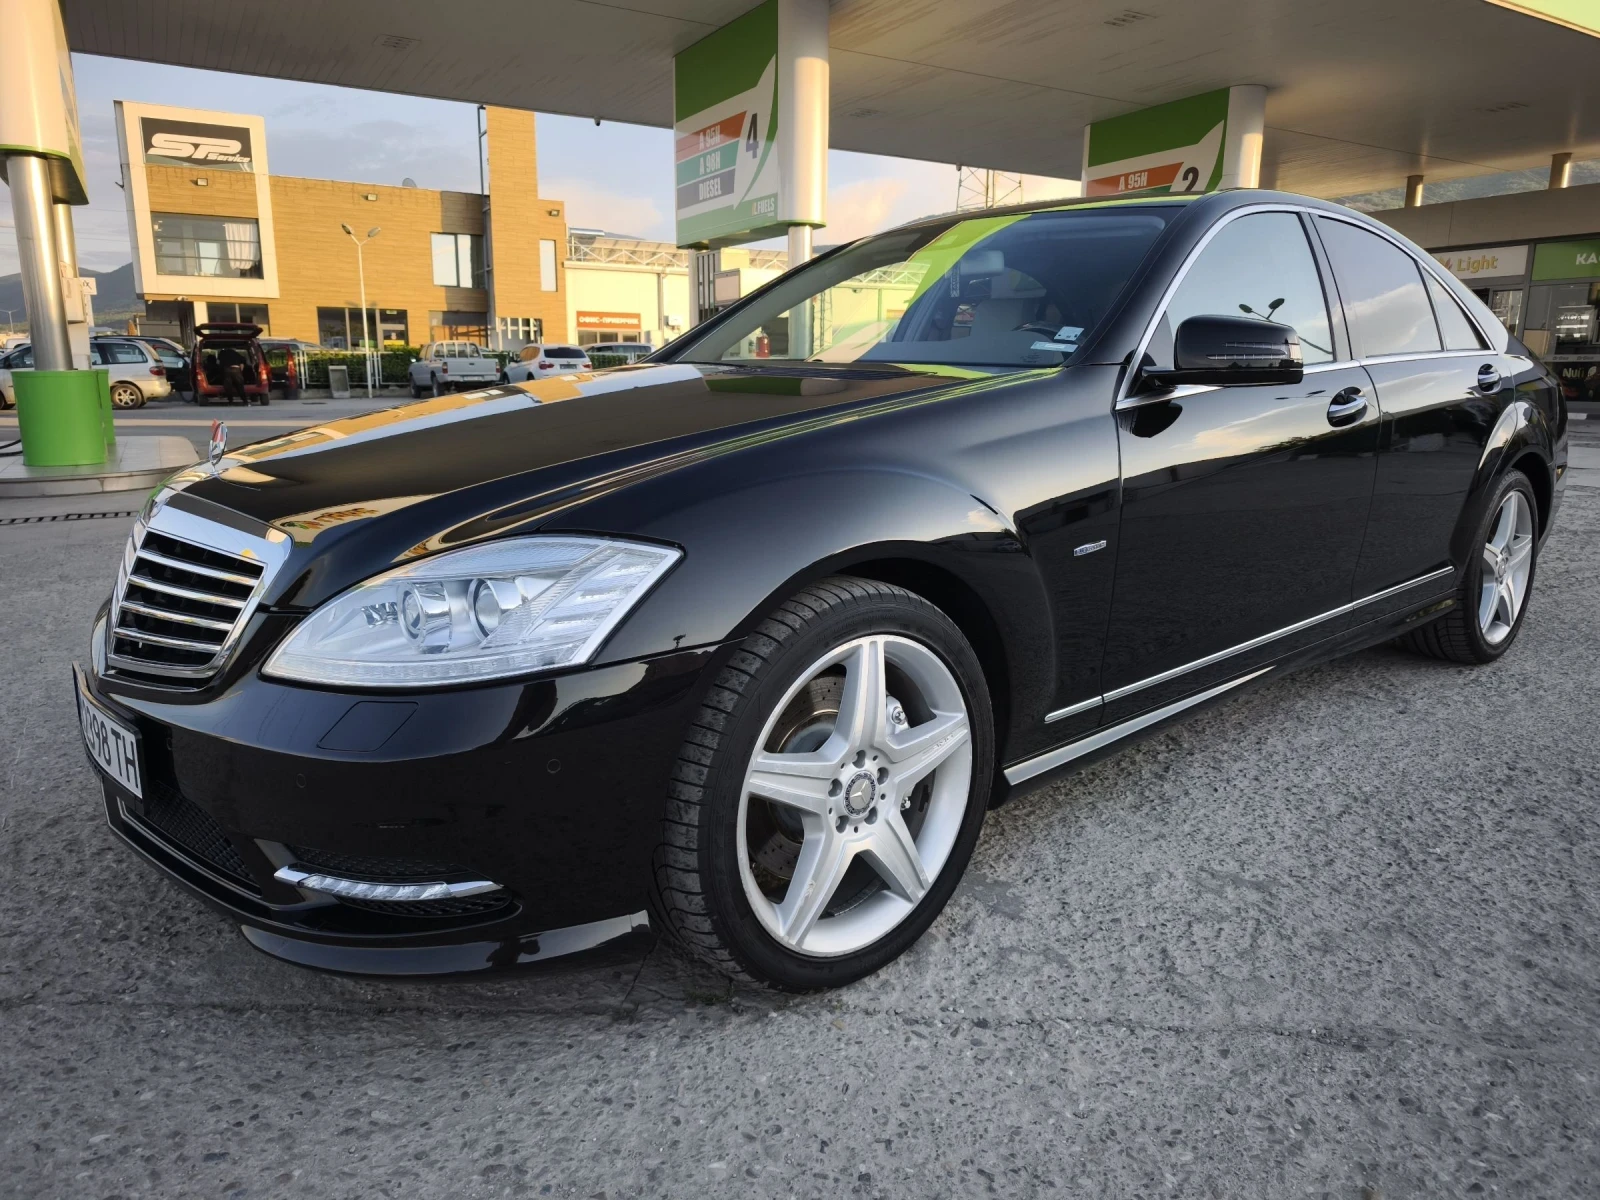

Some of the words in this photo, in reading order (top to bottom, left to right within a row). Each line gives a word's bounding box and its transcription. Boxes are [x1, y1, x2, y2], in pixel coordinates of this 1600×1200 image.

[147, 132, 242, 159] SP
[746, 113, 759, 159] 4
[206, 152, 251, 163] Service
[700, 158, 705, 174] A
[699, 178, 721, 200] DIESEL
[1118, 176, 1126, 191] A
[1127, 171, 1148, 189] 95H
[1182, 166, 1200, 192] 2
[1457, 256, 1498, 273] Light
[111, 727, 139, 789] TH
